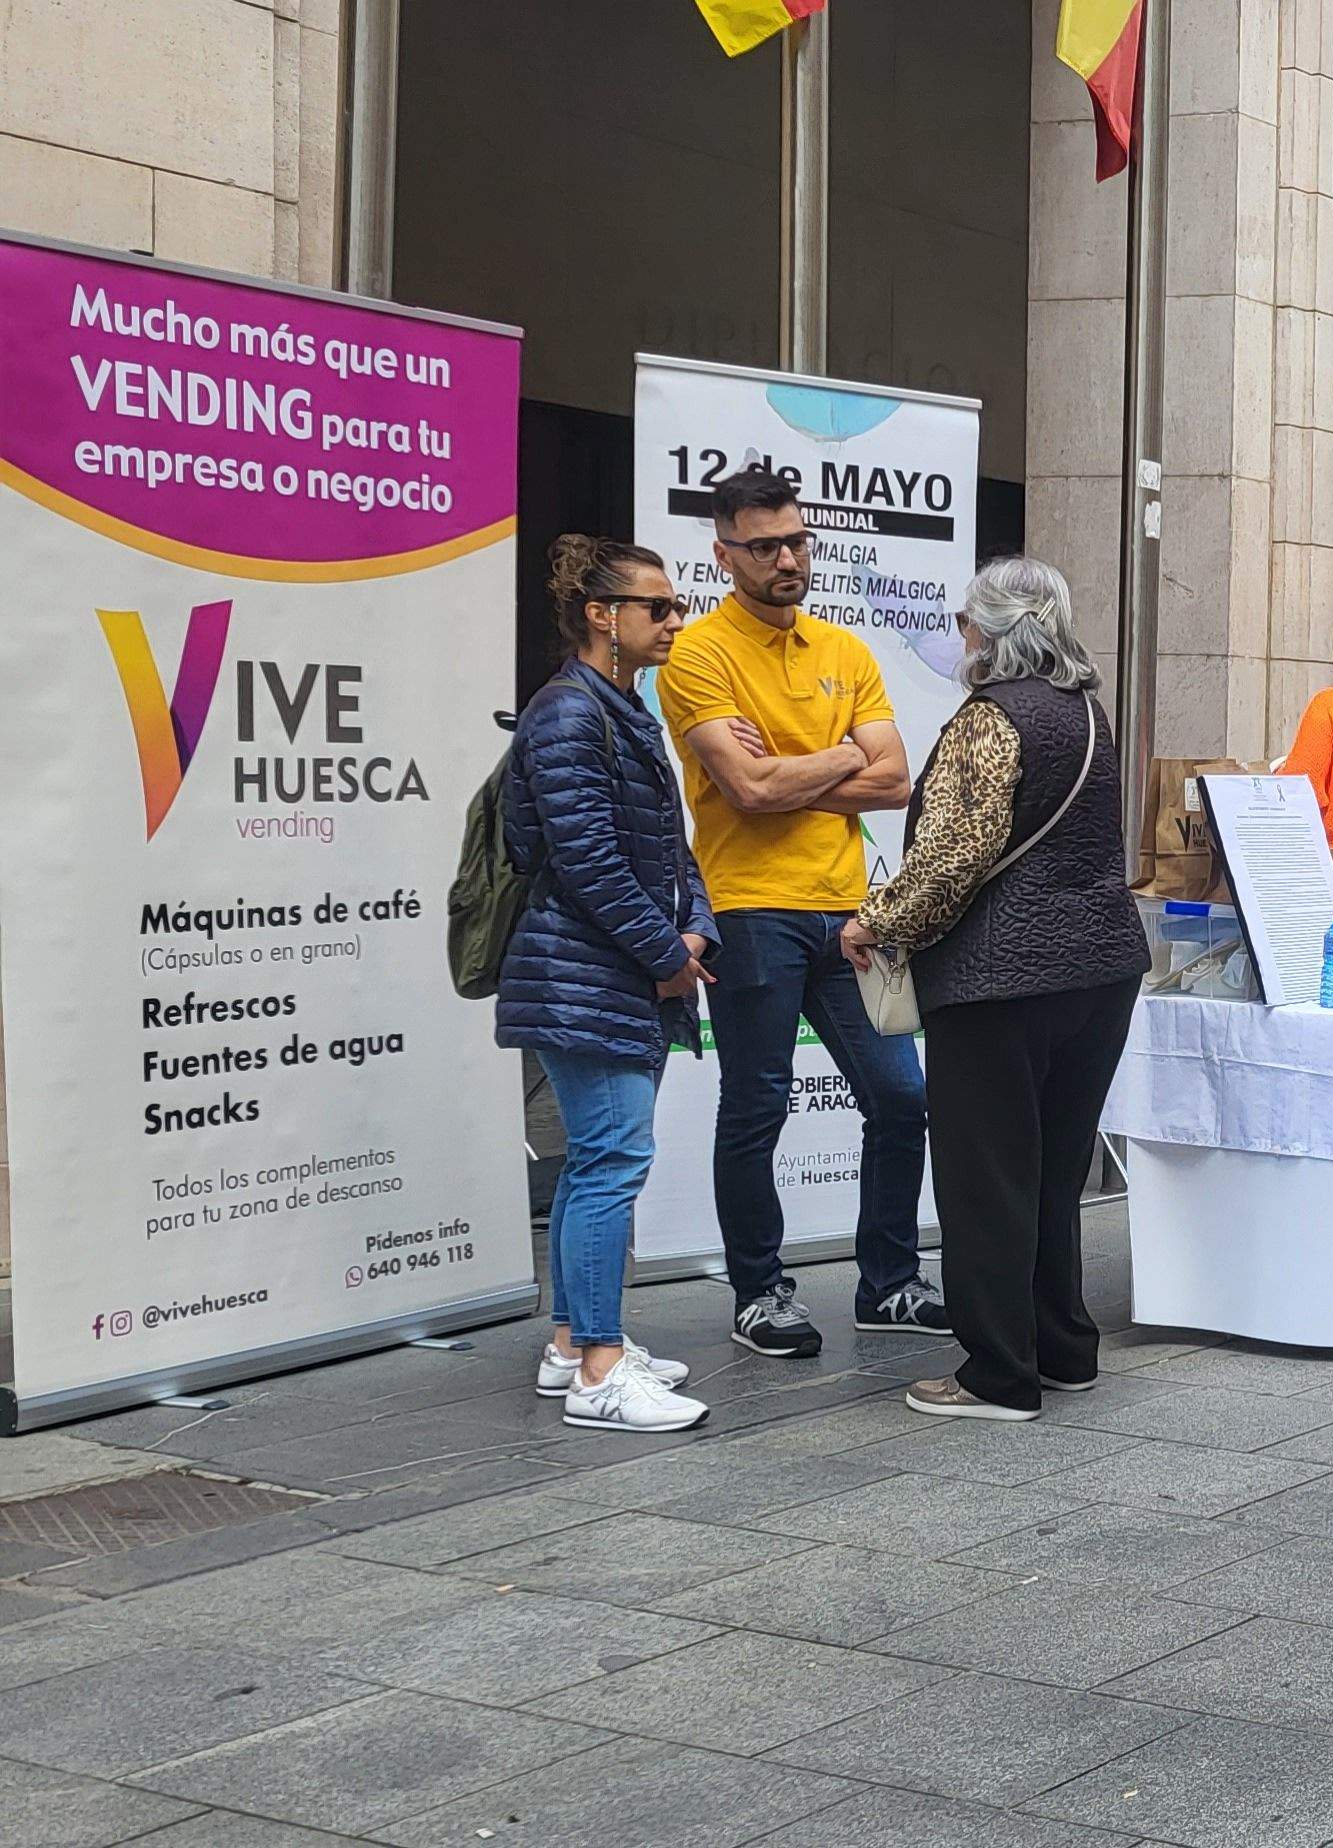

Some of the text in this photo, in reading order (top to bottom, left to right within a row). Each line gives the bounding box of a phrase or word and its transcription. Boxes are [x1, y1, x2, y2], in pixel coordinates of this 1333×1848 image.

[70, 282, 451, 388] Mucho más que un
[70, 353, 451, 459] VENDING para tu
[75, 439, 453, 513] empresa o negocio
[668, 445, 728, 490] 12
[821, 461, 953, 512] MAYO
[799, 507, 879, 532] MUNDIAL
[811, 541, 878, 566] MIALGIA
[675, 561, 689, 581] Y
[866, 574, 946, 602] MIÁLGICA
[808, 603, 866, 627] FATIGA
[871, 604, 952, 637] CRÓNICA)
[234, 756, 430, 803] HUESCA
[236, 809, 335, 842] vending
[140, 889, 422, 940] Máquinas de café
[140, 934, 362, 978] (Cápsulas o en grano)
[142, 992, 297, 1029] Refrescos
[143, 1032, 404, 1083] Fuentes de agua
[789, 1075, 851, 1096] OBIER
[806, 1094, 859, 1113] ARAG
[143, 1093, 260, 1136] Snacks
[152, 1147, 396, 1203] Todos los complementos
[776, 1168, 860, 1188] de Huesca
[777, 1147, 860, 1171] Ayuntamie
[146, 1174, 403, 1240] para tu zona de descanso
[366, 1218, 470, 1254] Pídenos info
[367, 1242, 474, 1280] 640 946 118
[142, 1286, 269, 1328] @vivehuesca
